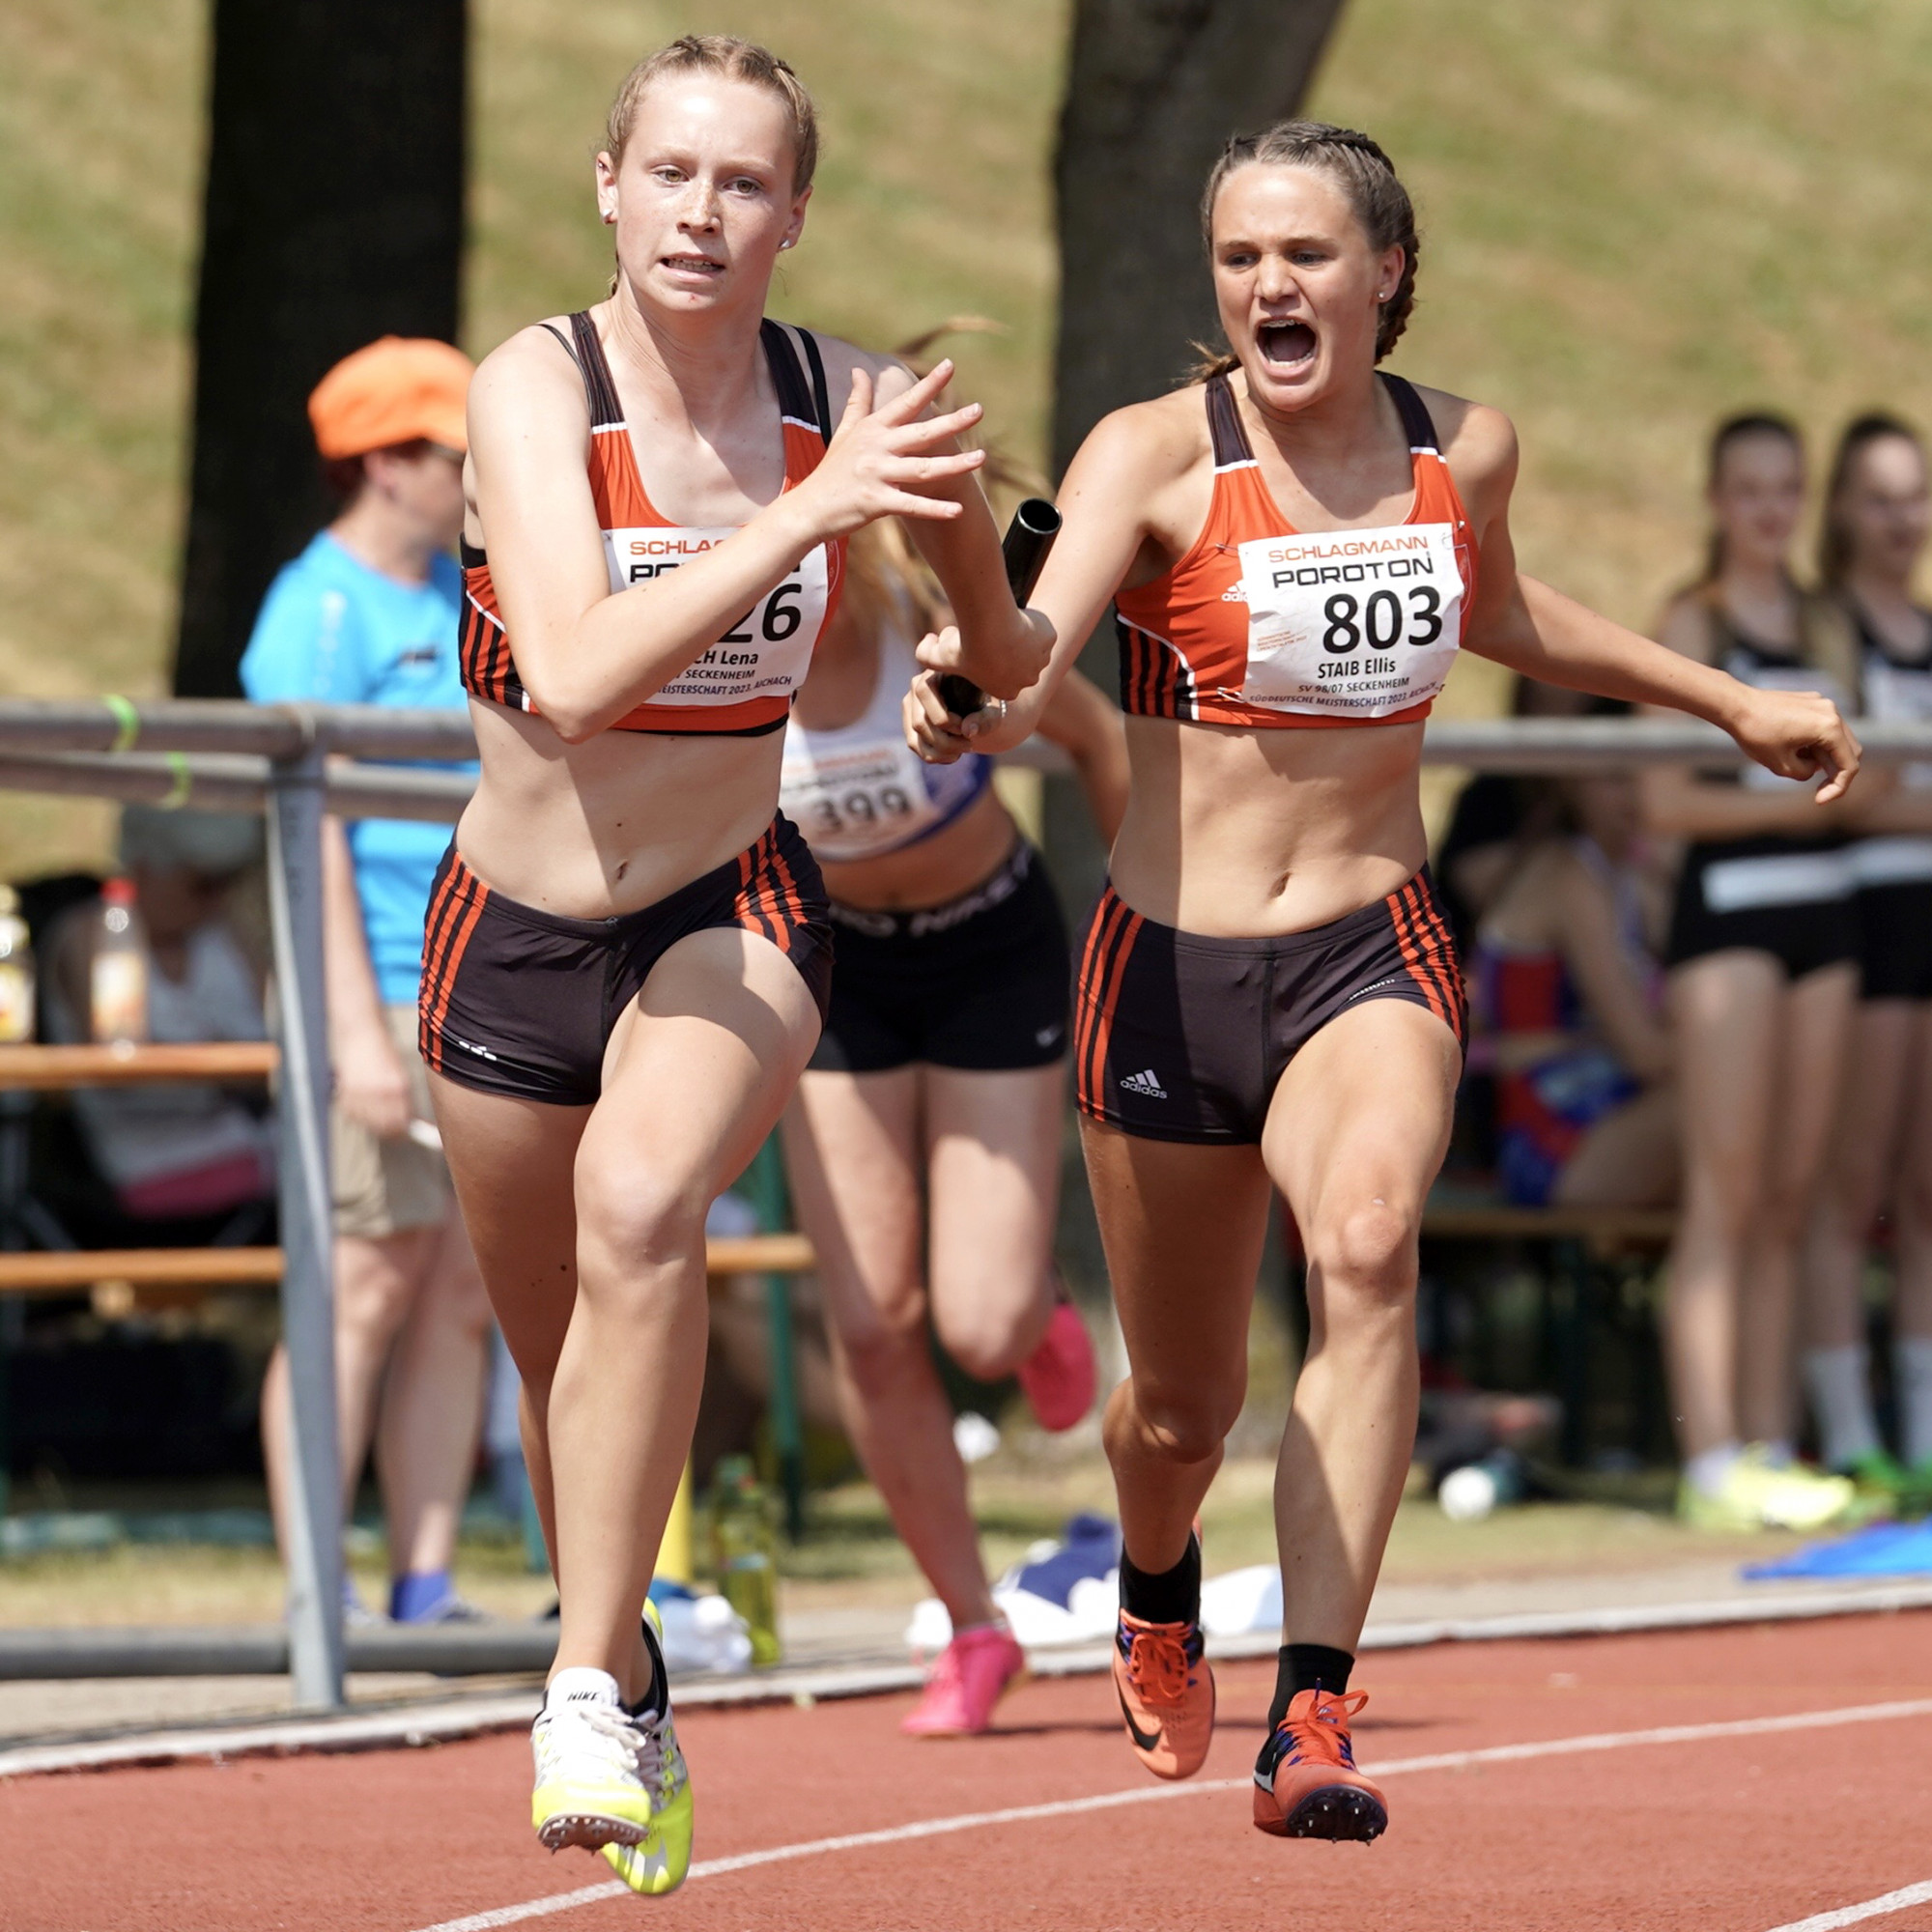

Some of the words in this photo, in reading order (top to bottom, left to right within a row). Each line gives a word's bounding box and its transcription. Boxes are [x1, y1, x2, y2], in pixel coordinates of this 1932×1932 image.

[630, 539, 724, 555] SCHLA
[1268, 536, 1429, 563] SCHLAGMANN
[1272, 556, 1434, 588] POROTON
[717, 582, 802, 643] 26
[1322, 585, 1443, 655] 803
[720, 650, 759, 666] Lena
[685, 668, 755, 680] SECKENHEIM
[1318, 660, 1360, 679] STAIB
[1365, 658, 1397, 675] Ellis
[1298, 685, 1313, 694] SV
[1315, 683, 1344, 694] 98/07
[1347, 677, 1410, 693] SECKENHEIM
[1249, 694, 1314, 704] SÜDDEUTSCHE
[1316, 696, 1386, 708] MEISTERSCHAFT
[1121, 1079, 1168, 1099] adidas
[567, 1691, 599, 1702] NIKE
